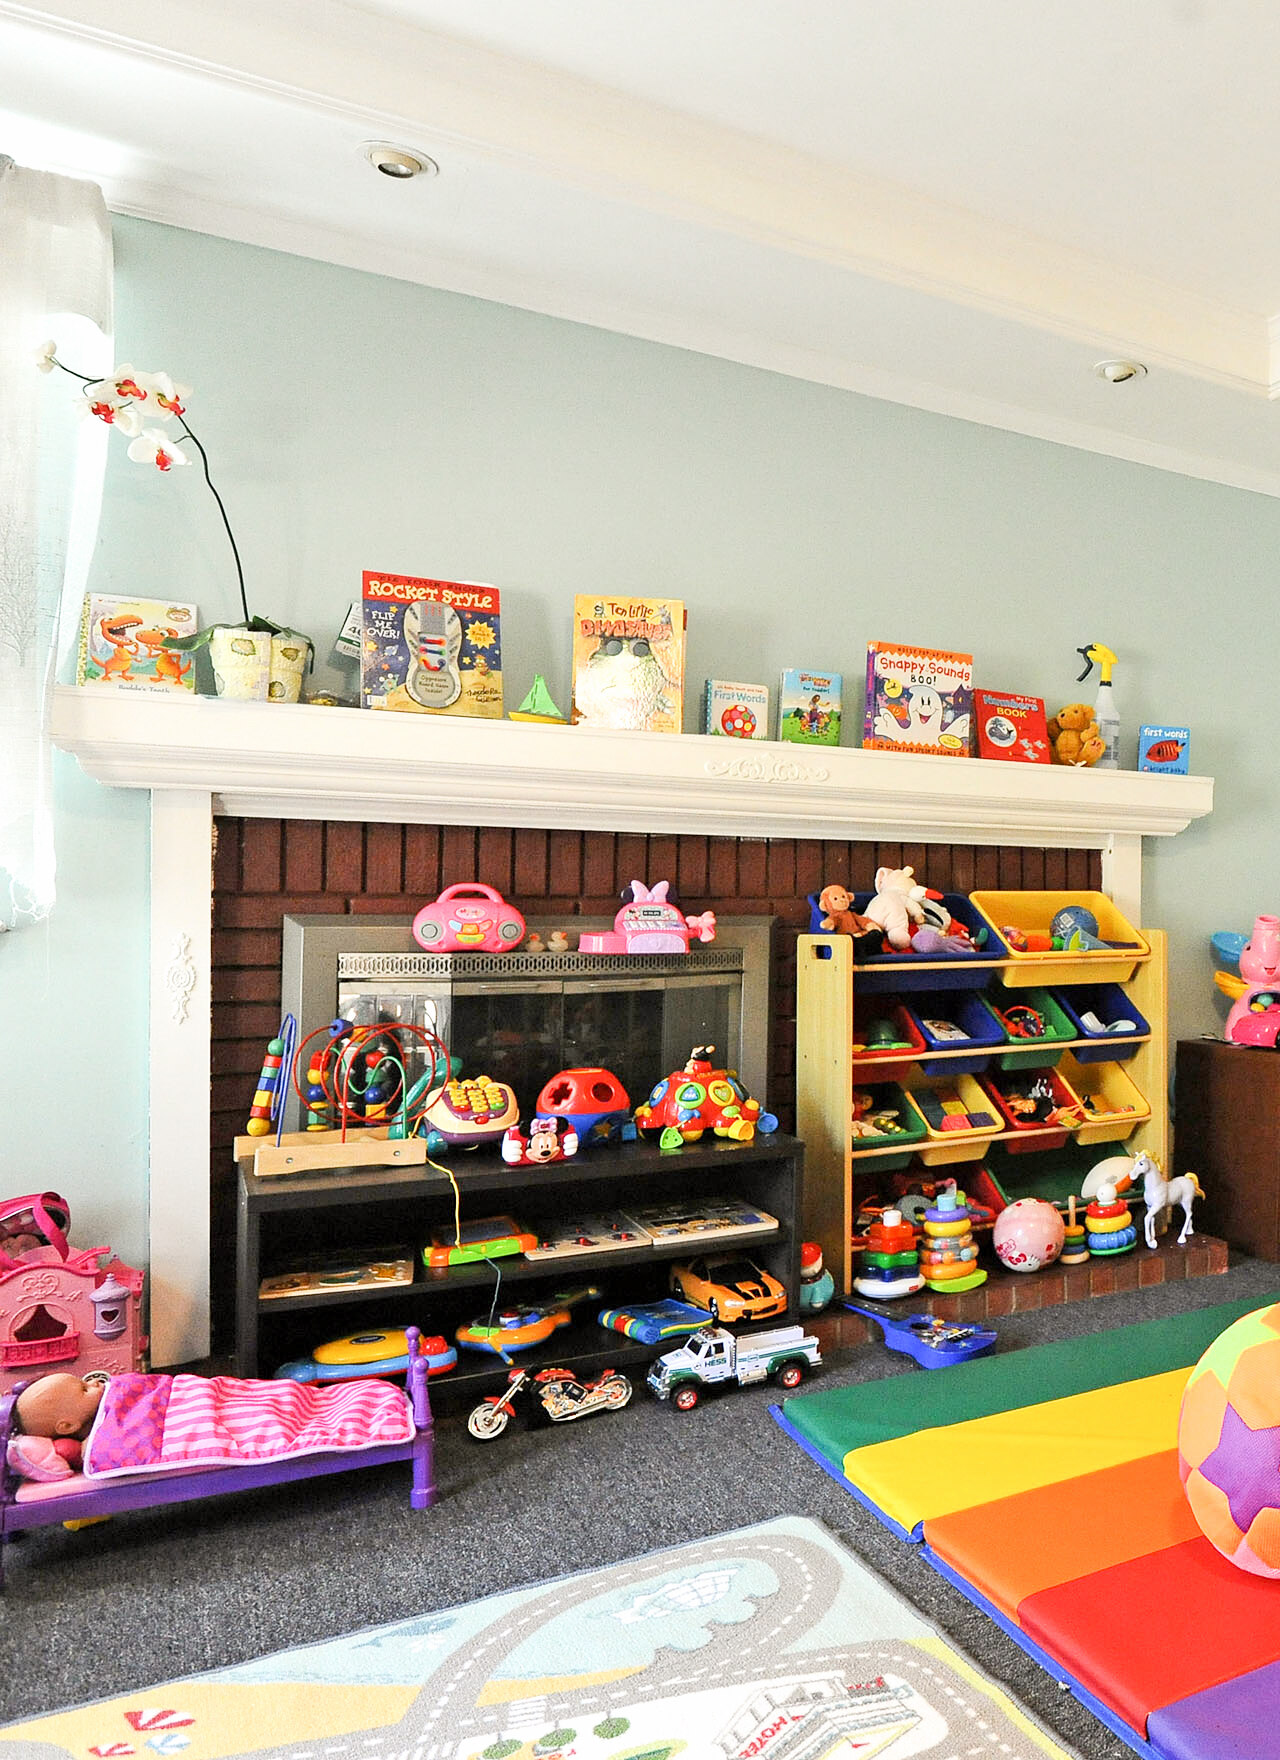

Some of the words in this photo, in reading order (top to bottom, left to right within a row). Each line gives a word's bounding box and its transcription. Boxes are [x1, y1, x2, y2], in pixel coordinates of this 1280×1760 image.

[368, 580, 438, 601] ROCKET
[442, 590, 493, 608] STYLE
[372, 611, 395, 620] FLIP
[608, 602, 627, 616] Ten
[629, 604, 654, 618] Little
[375, 621, 392, 629] ME
[367, 628, 400, 639] OVER!
[880, 657, 925, 674] Snappy
[929, 662, 970, 681] Sounds
[911, 675, 937, 685] BOO!
[714, 690, 735, 700] First
[736, 692, 766, 703] Words
[996, 707, 1027, 718] BOOK
[1144, 727, 1163, 737] first
[1164, 729, 1188, 738] words
[705, 1357, 727, 1368] HESS
